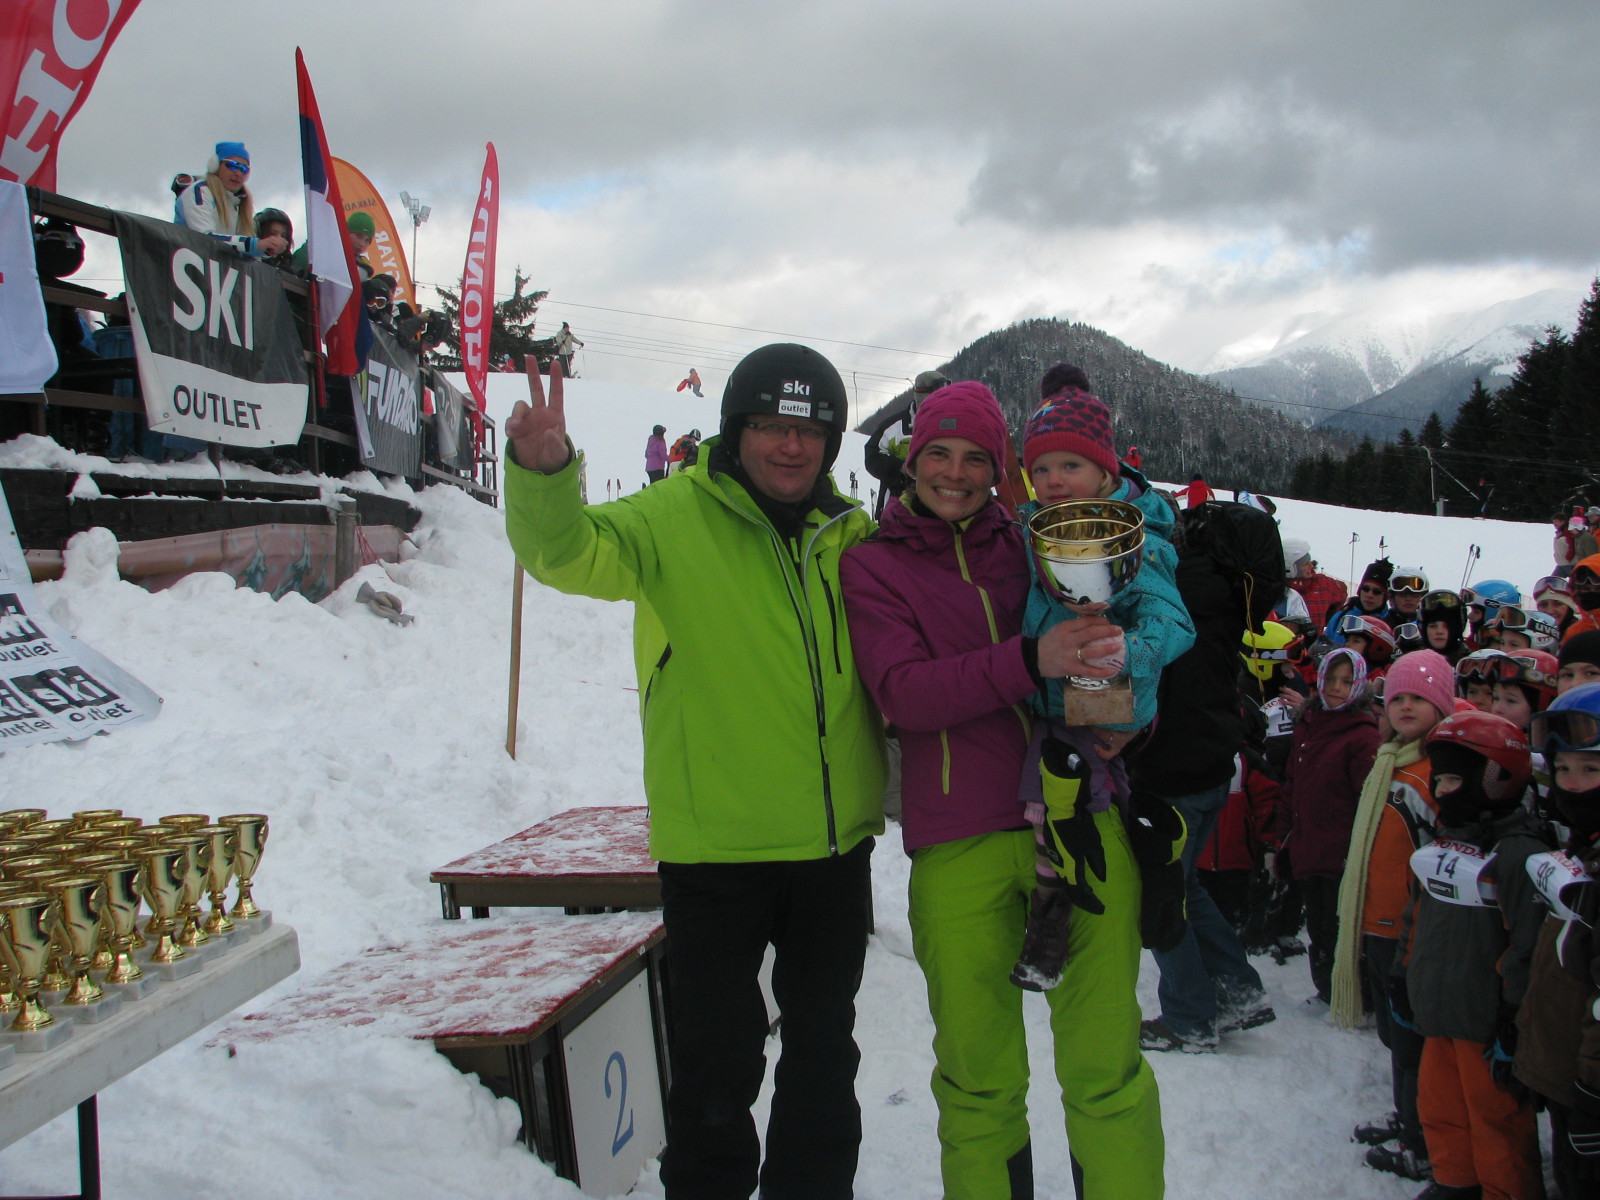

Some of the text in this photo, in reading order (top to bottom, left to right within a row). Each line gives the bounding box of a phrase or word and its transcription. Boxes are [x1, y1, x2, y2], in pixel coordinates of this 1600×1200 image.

[172, 247, 255, 351] SKI
[783, 380, 810, 396] ski
[173, 384, 262, 430] OUTLET
[781, 404, 809, 414] outlet
[33, 674, 108, 707] ski
[1435, 852, 1460, 879] 14
[1536, 861, 1556, 893] 98
[604, 1051, 634, 1157] 2
